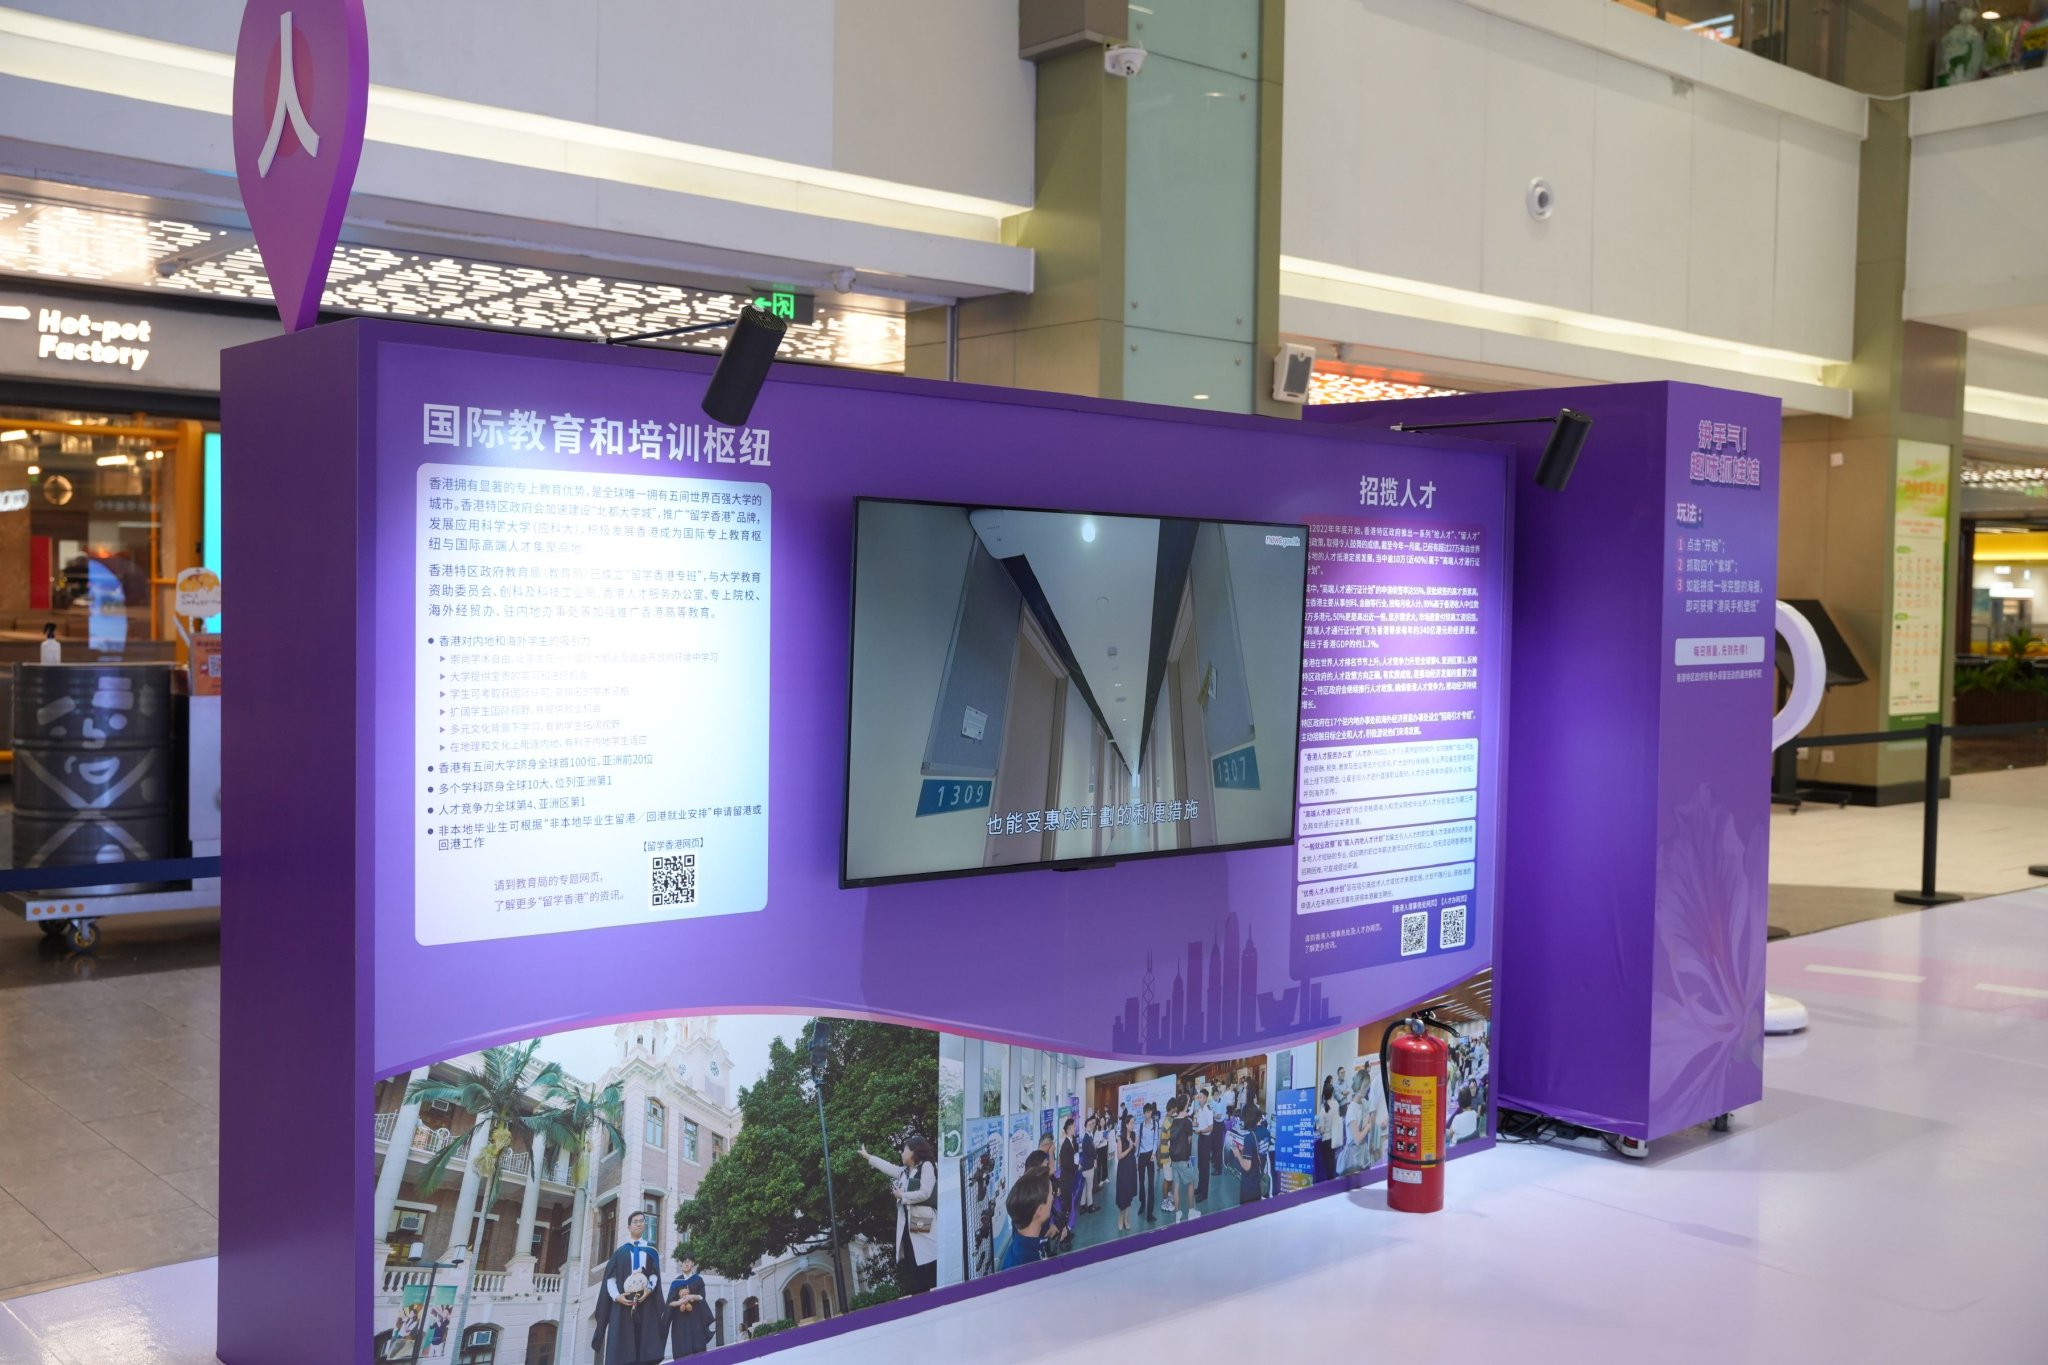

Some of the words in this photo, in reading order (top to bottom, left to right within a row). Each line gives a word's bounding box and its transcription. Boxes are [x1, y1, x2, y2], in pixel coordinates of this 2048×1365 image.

[38, 308, 151, 343] Hot-pot
[38, 334, 149, 371] Factory
[423, 403, 772, 467] 国际教育和培训枢纽
[1690, 451, 1760, 486] 趣味抓娃娃
[1360, 475, 1437, 509] 招揽人才
[936, 784, 984, 808] 1309
[986, 799, 1200, 837] 也能受惠於計劃的利便措施
[438, 836, 484, 851] 回港工作
